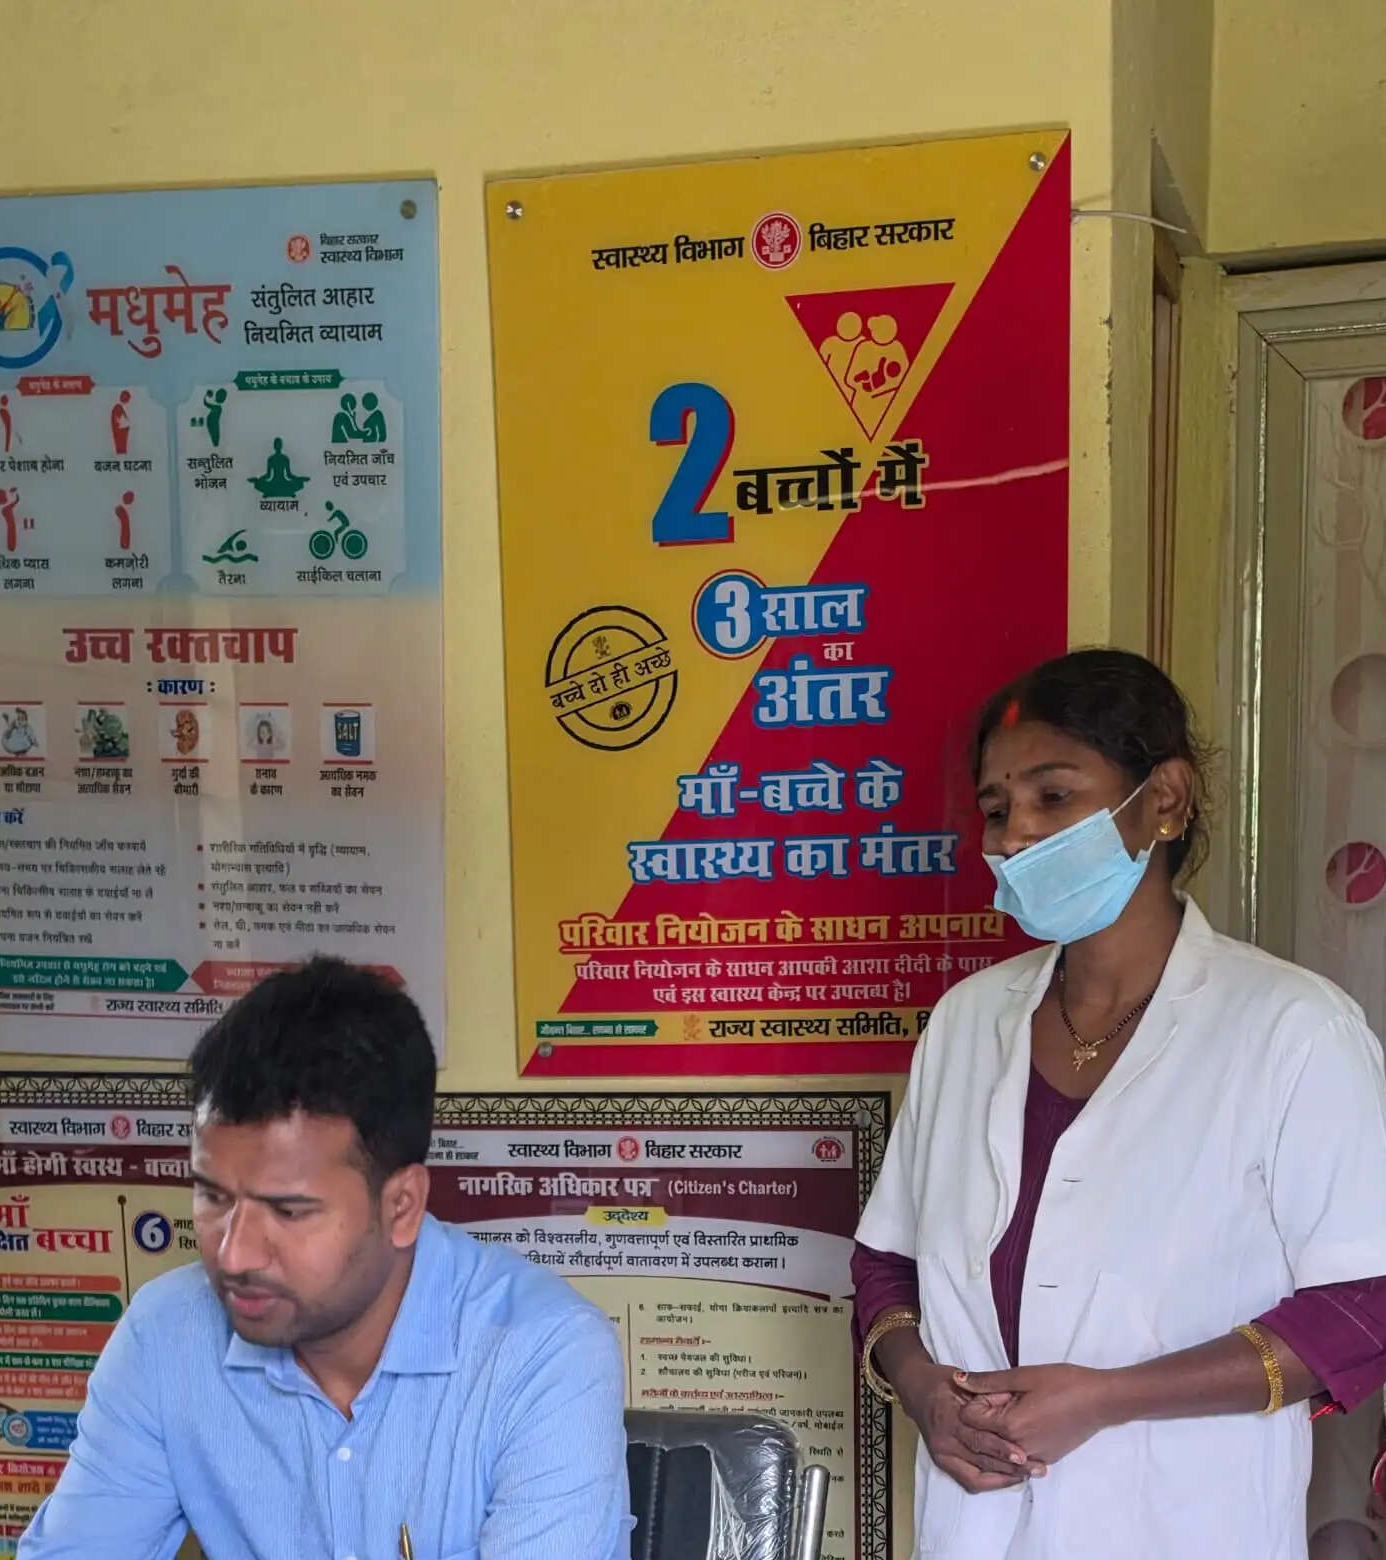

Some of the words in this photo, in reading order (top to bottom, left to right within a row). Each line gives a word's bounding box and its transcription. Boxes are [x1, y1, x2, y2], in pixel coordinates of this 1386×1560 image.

[320, 249, 362, 264] स्वास्थ्य
[365, 247, 404, 263] विभाग
[591, 241, 668, 271] स्वास्थ्य
[674, 232, 744, 264] विभाग
[808, 222, 869, 253] बिहार
[875, 217, 955, 244] सरकार
[250, 282, 316, 315] संतुलित
[322, 286, 375, 307] आहार
[86, 265, 231, 358] मधुमेह
[244, 319, 314, 345] नियमित
[319, 322, 384, 343] व्यायाम
[324, 448, 368, 466] नियमित
[649, 382, 734, 547] 2
[333, 472, 349, 487] एवं
[733, 447, 862, 515] बच्चों
[876, 440, 928, 508] में
[218, 569, 246, 585] तैरना
[714, 580, 752, 648] 3
[760, 587, 864, 632] साल
[63, 627, 134, 664] उच्च
[144, 627, 298, 664] रक्तचाप
[823, 640, 854, 663] का
[157, 679, 204, 697] कारण
[550, 681, 586, 708] बच्चे
[588, 672, 608, 694] दो
[610, 663, 630, 689] ही
[634, 647, 671, 676] अच्छे
[756, 657, 889, 722] अंतर
[338, 723, 359, 740] SALT
[856, 760, 903, 808] के
[4, 808, 24, 826] करें
[629, 842, 772, 880] स्वास्थ्य
[785, 838, 850, 875] का
[862, 826, 958, 874] मंतर
[561, 915, 650, 947] परिवार
[656, 912, 769, 944] नियोजन
[775, 911, 803, 942] के
[811, 915, 890, 941] साधन
[576, 961, 629, 980] परिवार
[634, 959, 700, 979] नियोजन
[706, 959, 722, 978] के
[726, 960, 773, 977] साधन
[779, 956, 838, 975] आपकी
[842, 958, 890, 975] आशा
[895, 954, 932, 974] दीदी
[936, 954, 953, 972] के
[106, 999, 134, 1012] राज्य
[137, 1000, 180, 1013] स्वास्थ्य
[653, 984, 677, 1003] एवं
[681, 987, 706, 1004] इस
[710, 986, 763, 1002] स्वास्थ्य
[768, 983, 801, 1001] केन्द्र
[806, 984, 827, 1000] पर
[831, 983, 890, 999] उपलब्ध
[709, 1020, 755, 1038] राज्य
[760, 1018, 830, 1037] स्वास्थ्य
[837, 1011, 909, 1037] समिति,
[10, 1121, 58, 1137] स्वास्थ्य
[61, 1119, 105, 1136] विभाग
[137, 1120, 174, 1137] बिहार
[508, 1143, 560, 1158] स्वास्थ्य
[565, 1140, 612, 1158] विभाग
[645, 1140, 686, 1159] बिहार
[689, 1144, 743, 1159] सरकार
[23, 1152, 66, 1176] होगी
[73, 1157, 123, 1176] स्वस्थ
[458, 1172, 534, 1196] नागरिक
[539, 1172, 619, 1197] अधिकार
[621, 1178, 661, 1197] पत्र
[668, 1179, 735, 1198] (Citizen's
[739, 1179, 798, 1198] Charter)
[33, 1228, 114, 1253] बच्चा
[141, 1215, 164, 1249] 6
[515, 1229, 530, 1244] को
[534, 1229, 602, 1246] विश्वसनीय,
[605, 1231, 669, 1250] गुणवत्तापूर्ण
[674, 1231, 690, 1246] एवं
[694, 1231, 745, 1246] विस्तारित
[749, 1231, 799, 1246] प्राथमिक
[569, 1250, 622, 1270] सौहार्दपूर्ण
[626, 1255, 678, 1268] वातावरण
[681, 1252, 690, 1267] में
[693, 1255, 738, 1269] उपलब्ध
[742, 1256, 777, 1269] कराना
